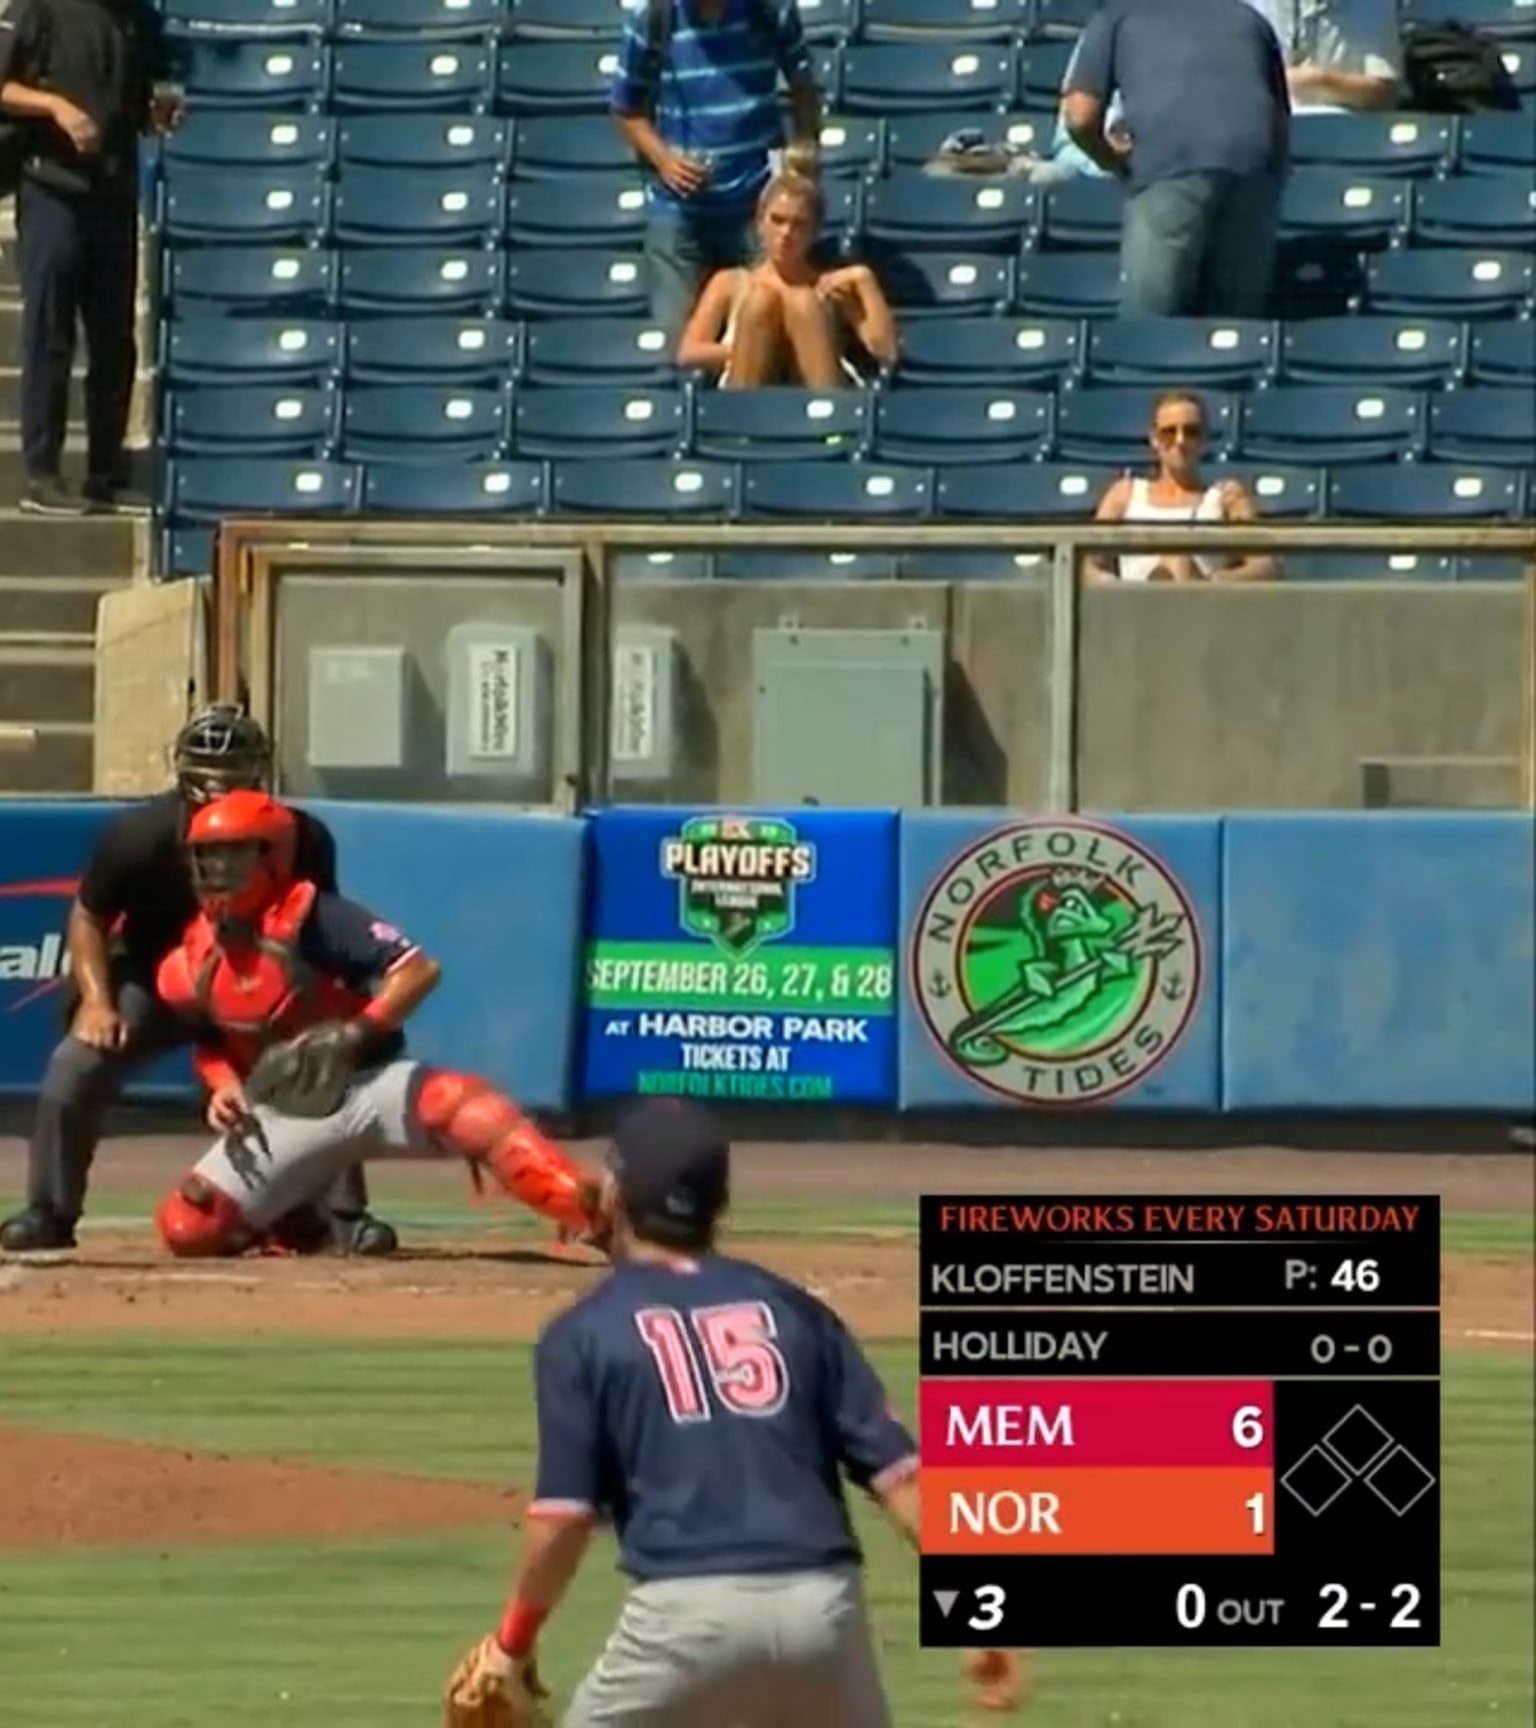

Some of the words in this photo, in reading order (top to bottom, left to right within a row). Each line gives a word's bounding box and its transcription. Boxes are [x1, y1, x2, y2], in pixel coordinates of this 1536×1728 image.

[665, 843, 811, 878] PLAYOFFS
[928, 831, 1146, 944] NORFOLK
[587, 957, 726, 996] SEPTEMBER
[732, 962, 775, 999] 26,
[781, 962, 824, 1001] 27,
[831, 963, 851, 998] &
[857, 963, 893, 999] 28
[605, 1020, 631, 1036] AT
[639, 1012, 774, 1040] HARBOR
[782, 1017, 869, 1043] PARK
[680, 1043, 762, 1070] TICKETS
[765, 1045, 792, 1072] AT
[1023, 1024, 1164, 1095] TIDES
[634, 1300, 791, 1424] 15
